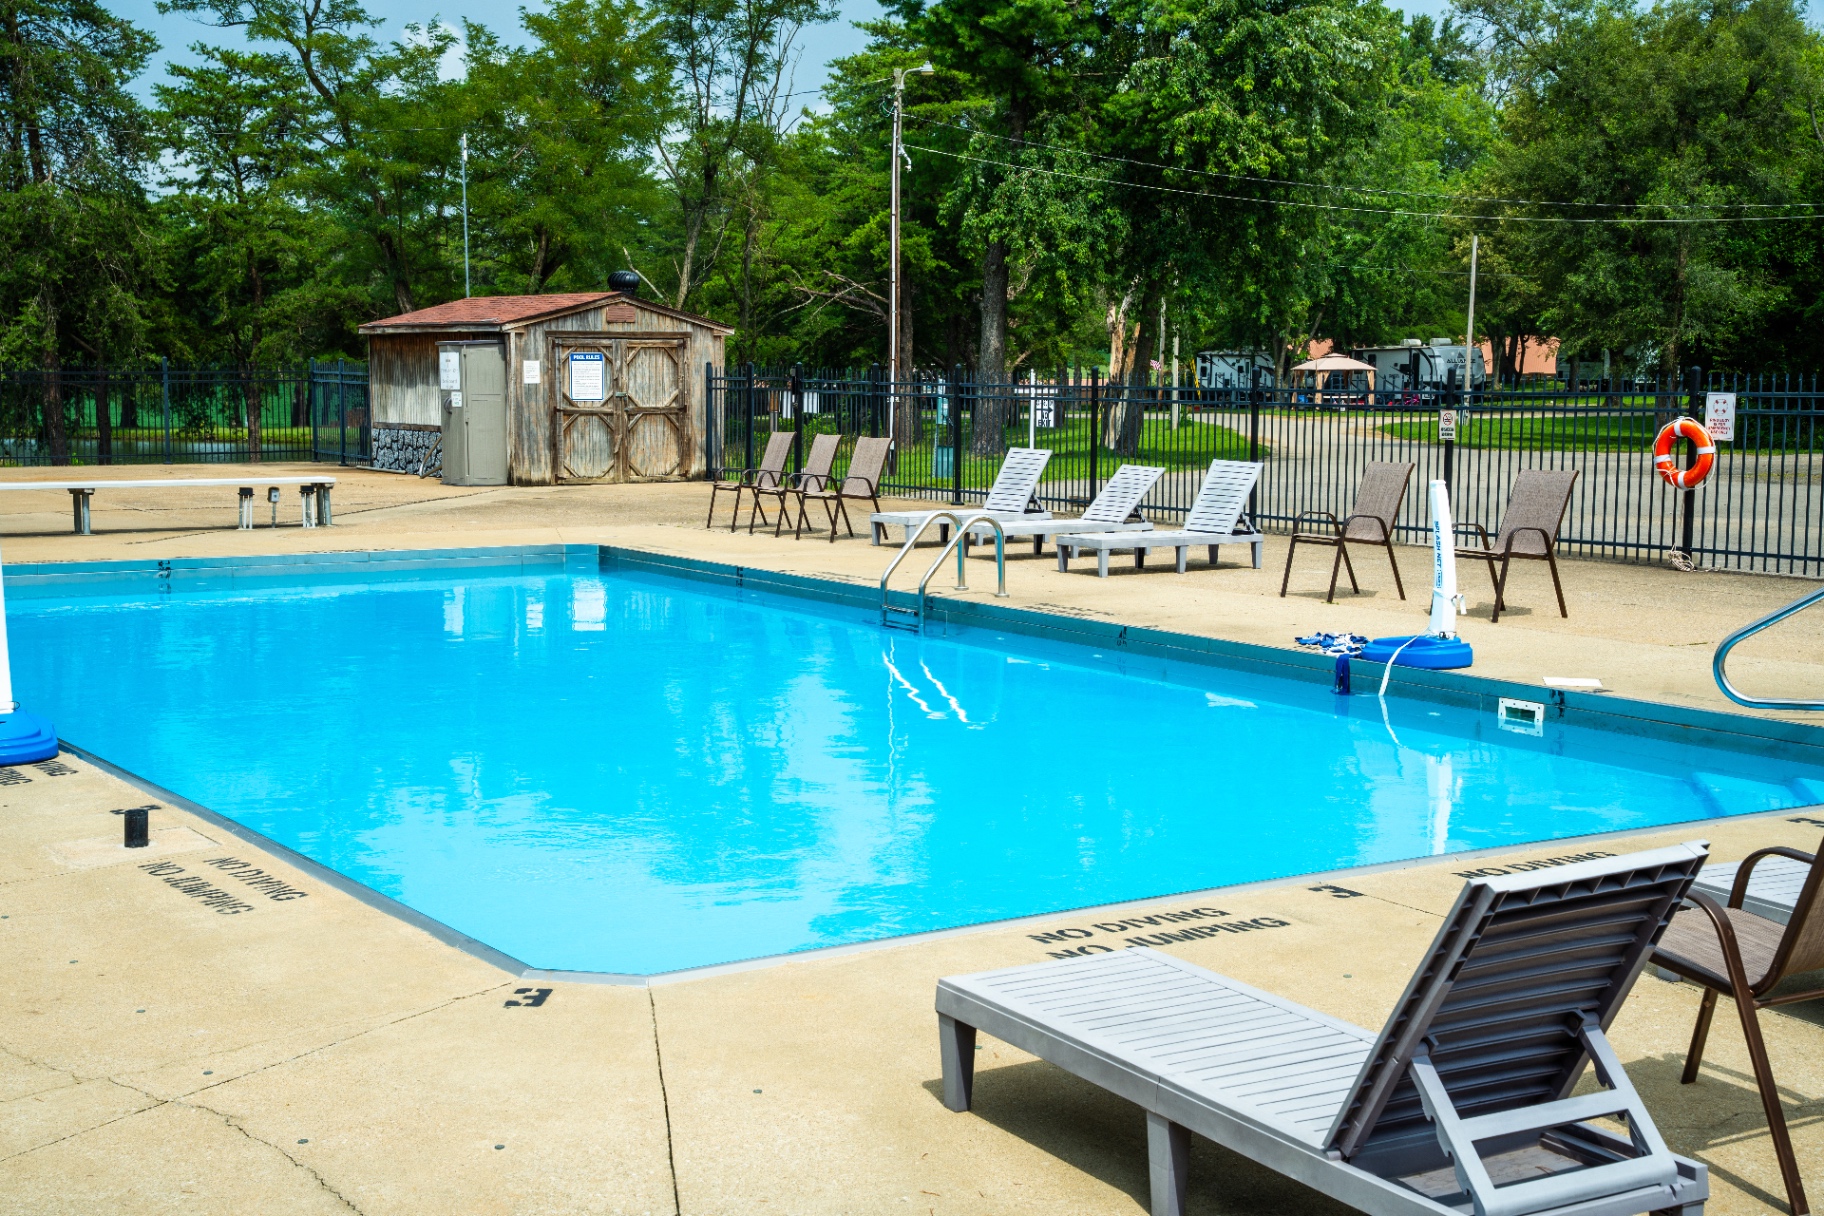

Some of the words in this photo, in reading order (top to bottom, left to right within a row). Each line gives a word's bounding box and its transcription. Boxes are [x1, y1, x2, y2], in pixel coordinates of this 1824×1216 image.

[137, 861, 185, 876] NO
[162, 876, 255, 915] JUMPING
[202, 857, 251, 870] NO
[228, 869, 309, 901] DIVING
[1450, 867, 1511, 880] NO
[1025, 928, 1094, 944] NO
[1092, 907, 1232, 933] DIVING
[1045, 944, 1115, 960] NO
[1123, 917, 1291, 948] JUMPING
[503, 987, 554, 1009] 3
